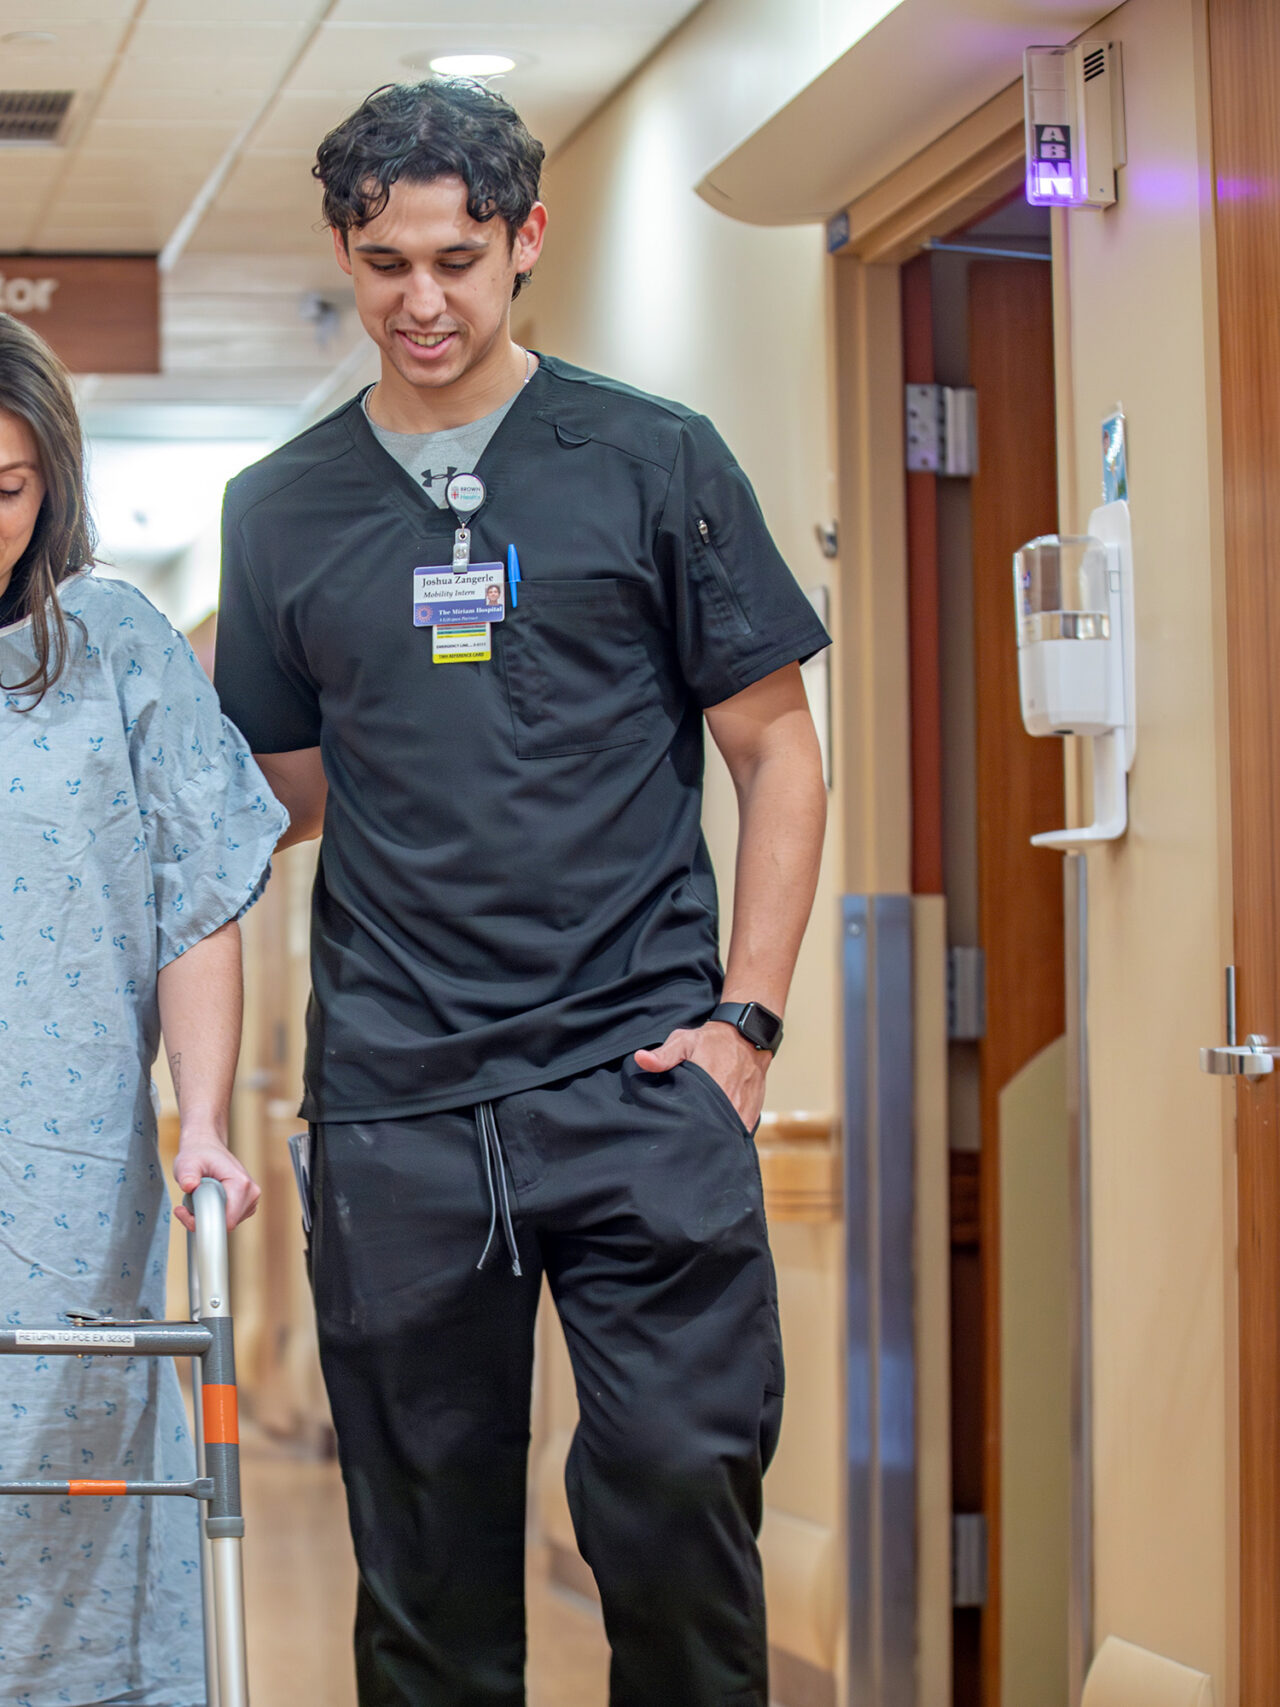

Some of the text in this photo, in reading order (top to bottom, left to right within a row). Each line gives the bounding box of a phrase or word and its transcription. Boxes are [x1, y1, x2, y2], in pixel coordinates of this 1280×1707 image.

[422, 574, 494, 588] Joshua Zangerle
[423, 589, 476, 599] Mobility Intern
[452, 607, 475, 615] Miriam
[476, 606, 502, 614] Hospital
[19, 1332, 56, 1341] RETURN
[59, 1333, 71, 1342] TO
